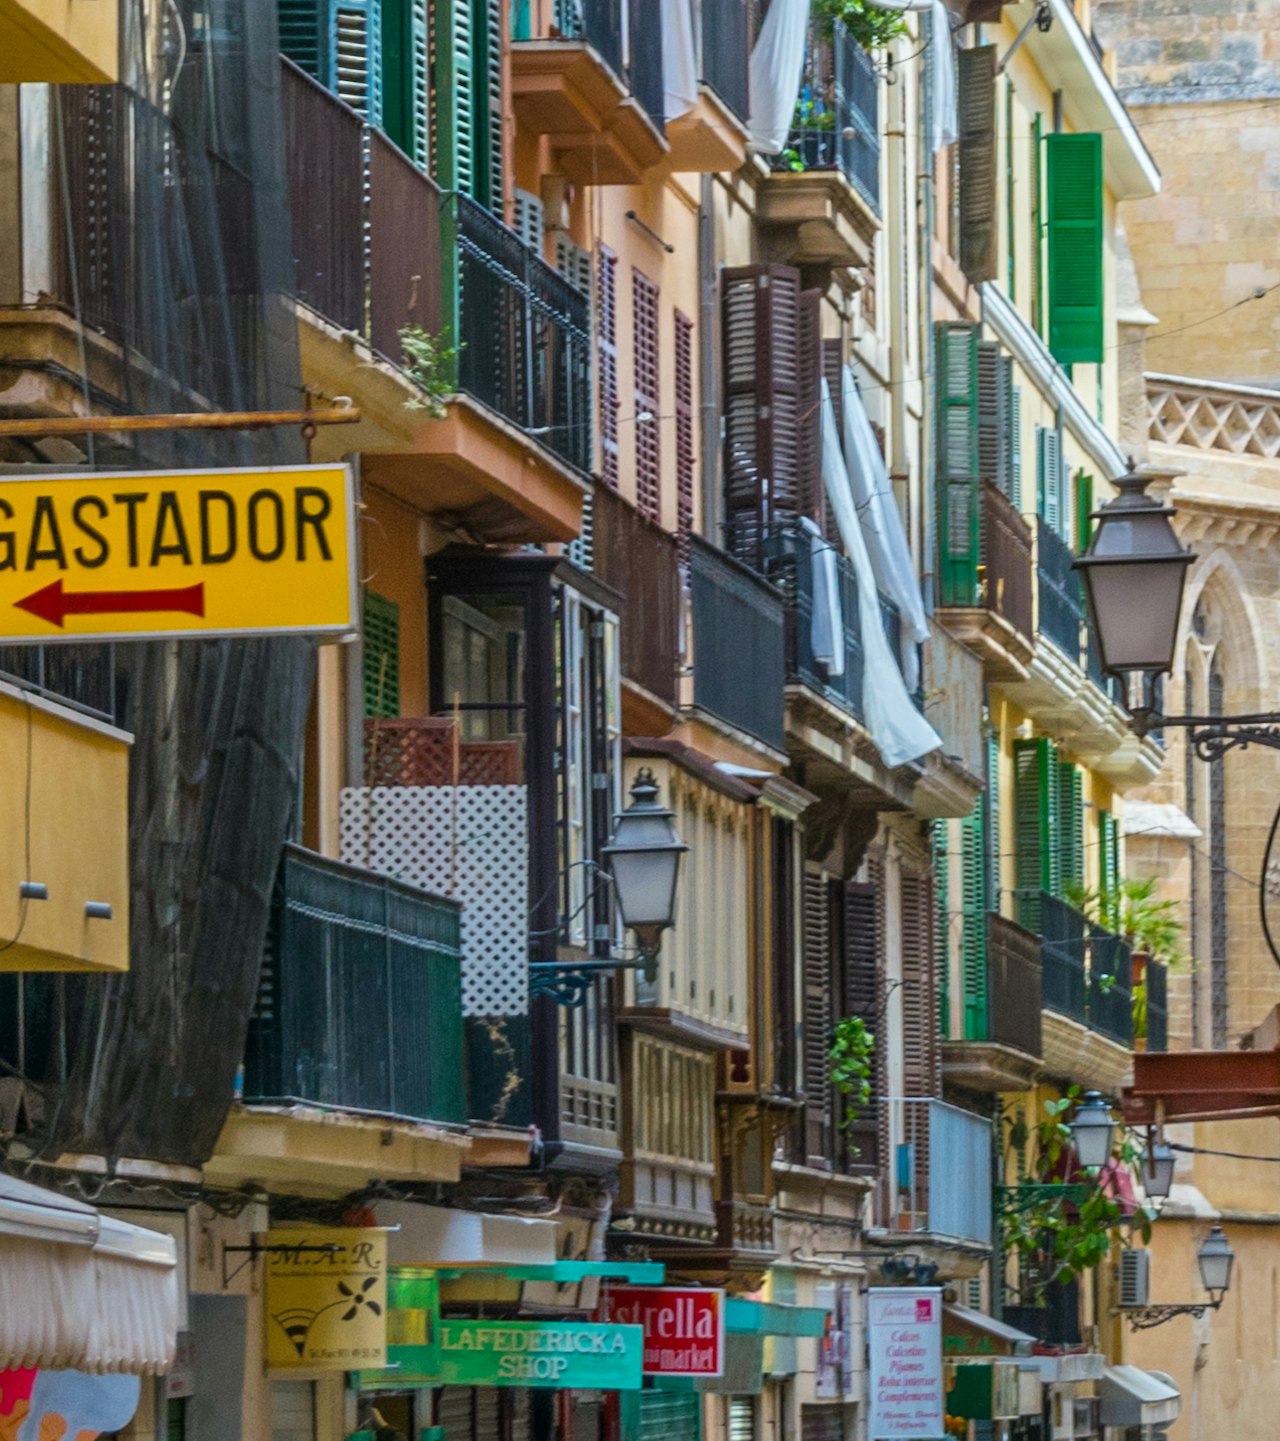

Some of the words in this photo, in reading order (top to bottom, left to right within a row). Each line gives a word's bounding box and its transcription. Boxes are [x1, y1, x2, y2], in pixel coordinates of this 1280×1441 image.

[597, 1296, 715, 1339] Estrella
[440, 1326, 627, 1354] LAFEDERICKA
[498, 1355, 568, 1380] SHOP
